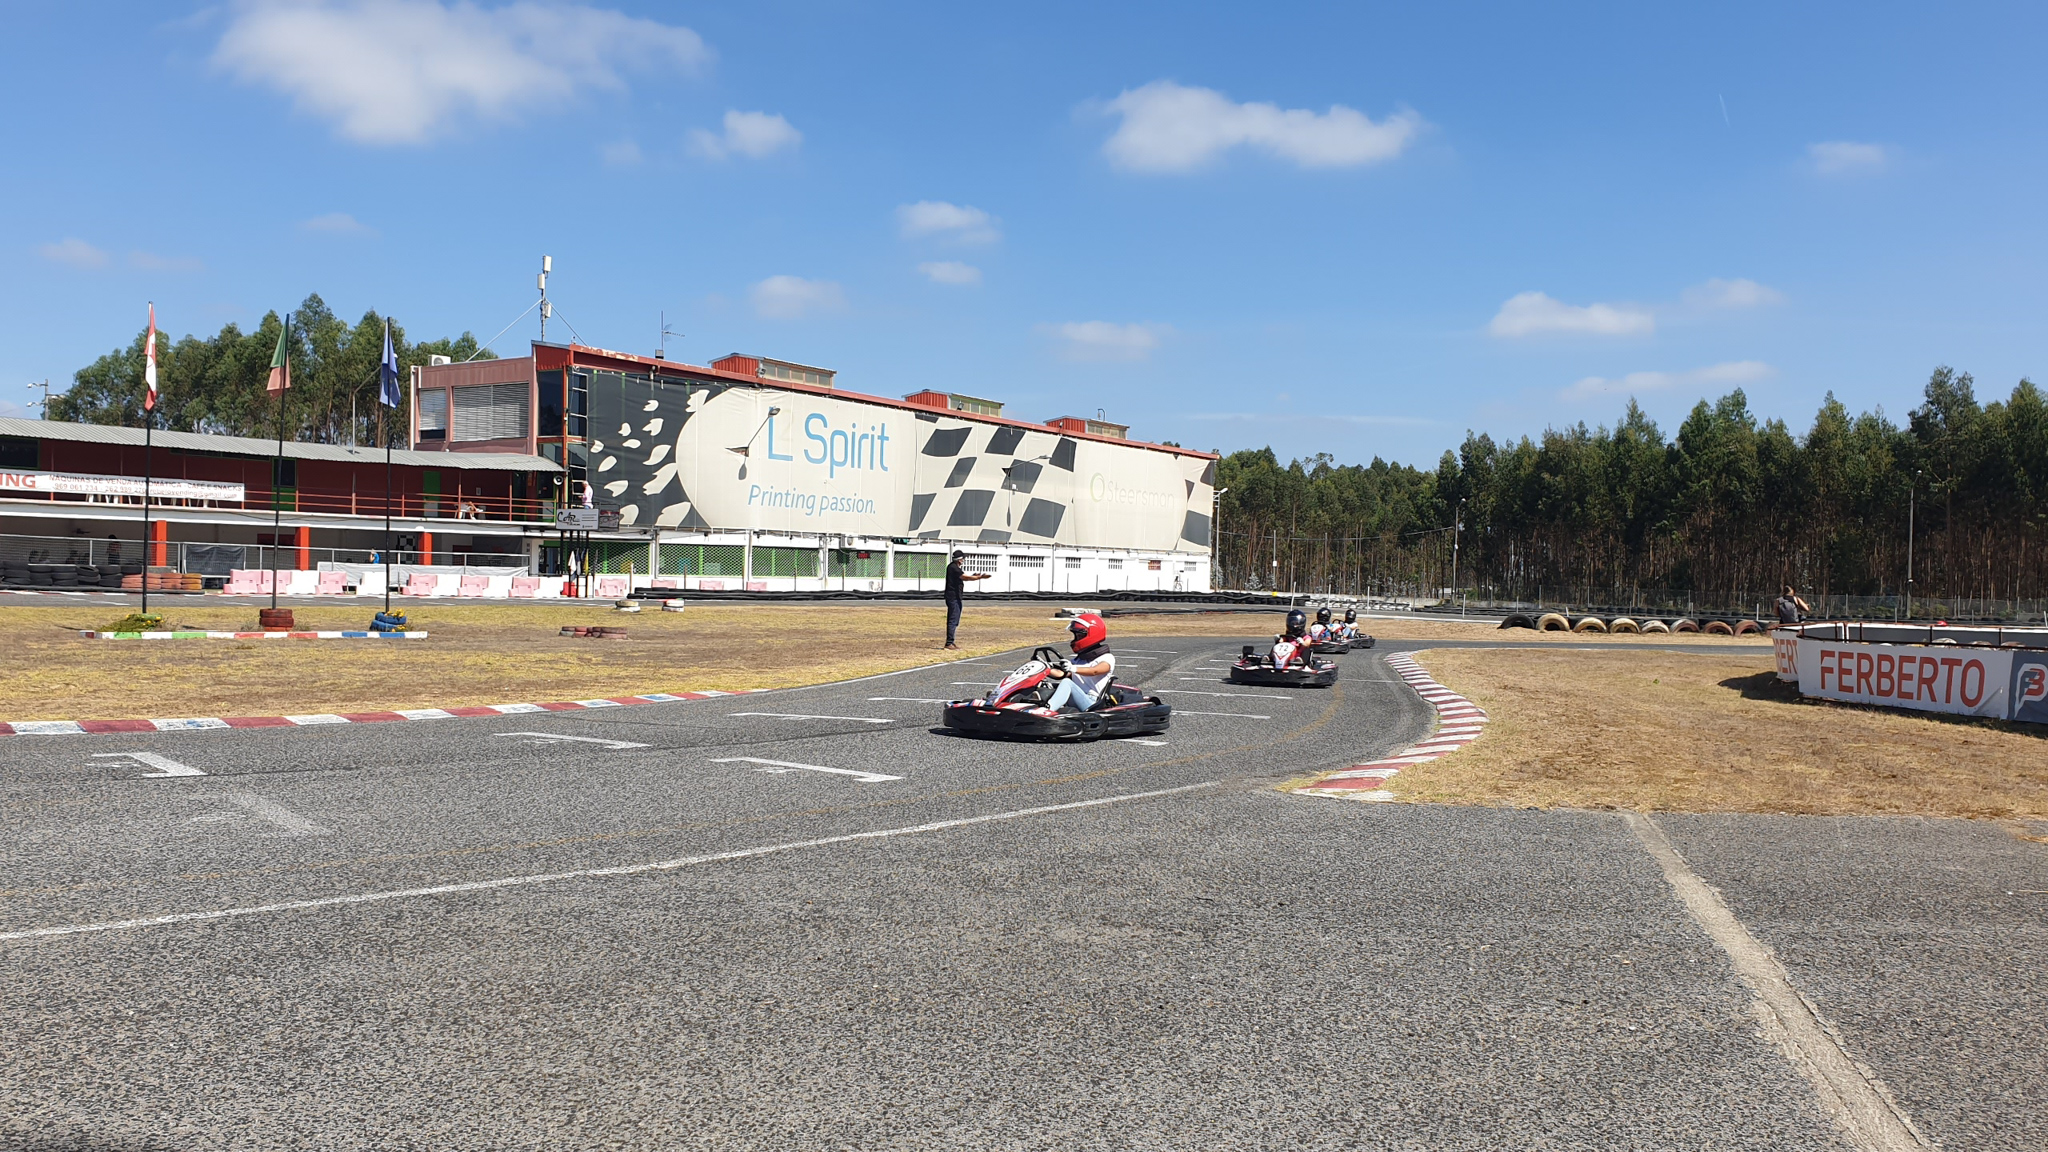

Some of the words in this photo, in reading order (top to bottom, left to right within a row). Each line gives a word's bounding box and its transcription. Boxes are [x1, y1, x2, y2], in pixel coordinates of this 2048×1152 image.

[768, 407, 793, 461] L
[804, 413, 889, 479] Spirit
[134, 479, 181, 488] AUOMÁTICA
[214, 483, 242, 491] SNACKS
[748, 485, 816, 516] Printing
[818, 493, 876, 517] passion.
[1279, 644, 1289, 652] 72
[1821, 650, 1985, 708] FERBERTO
